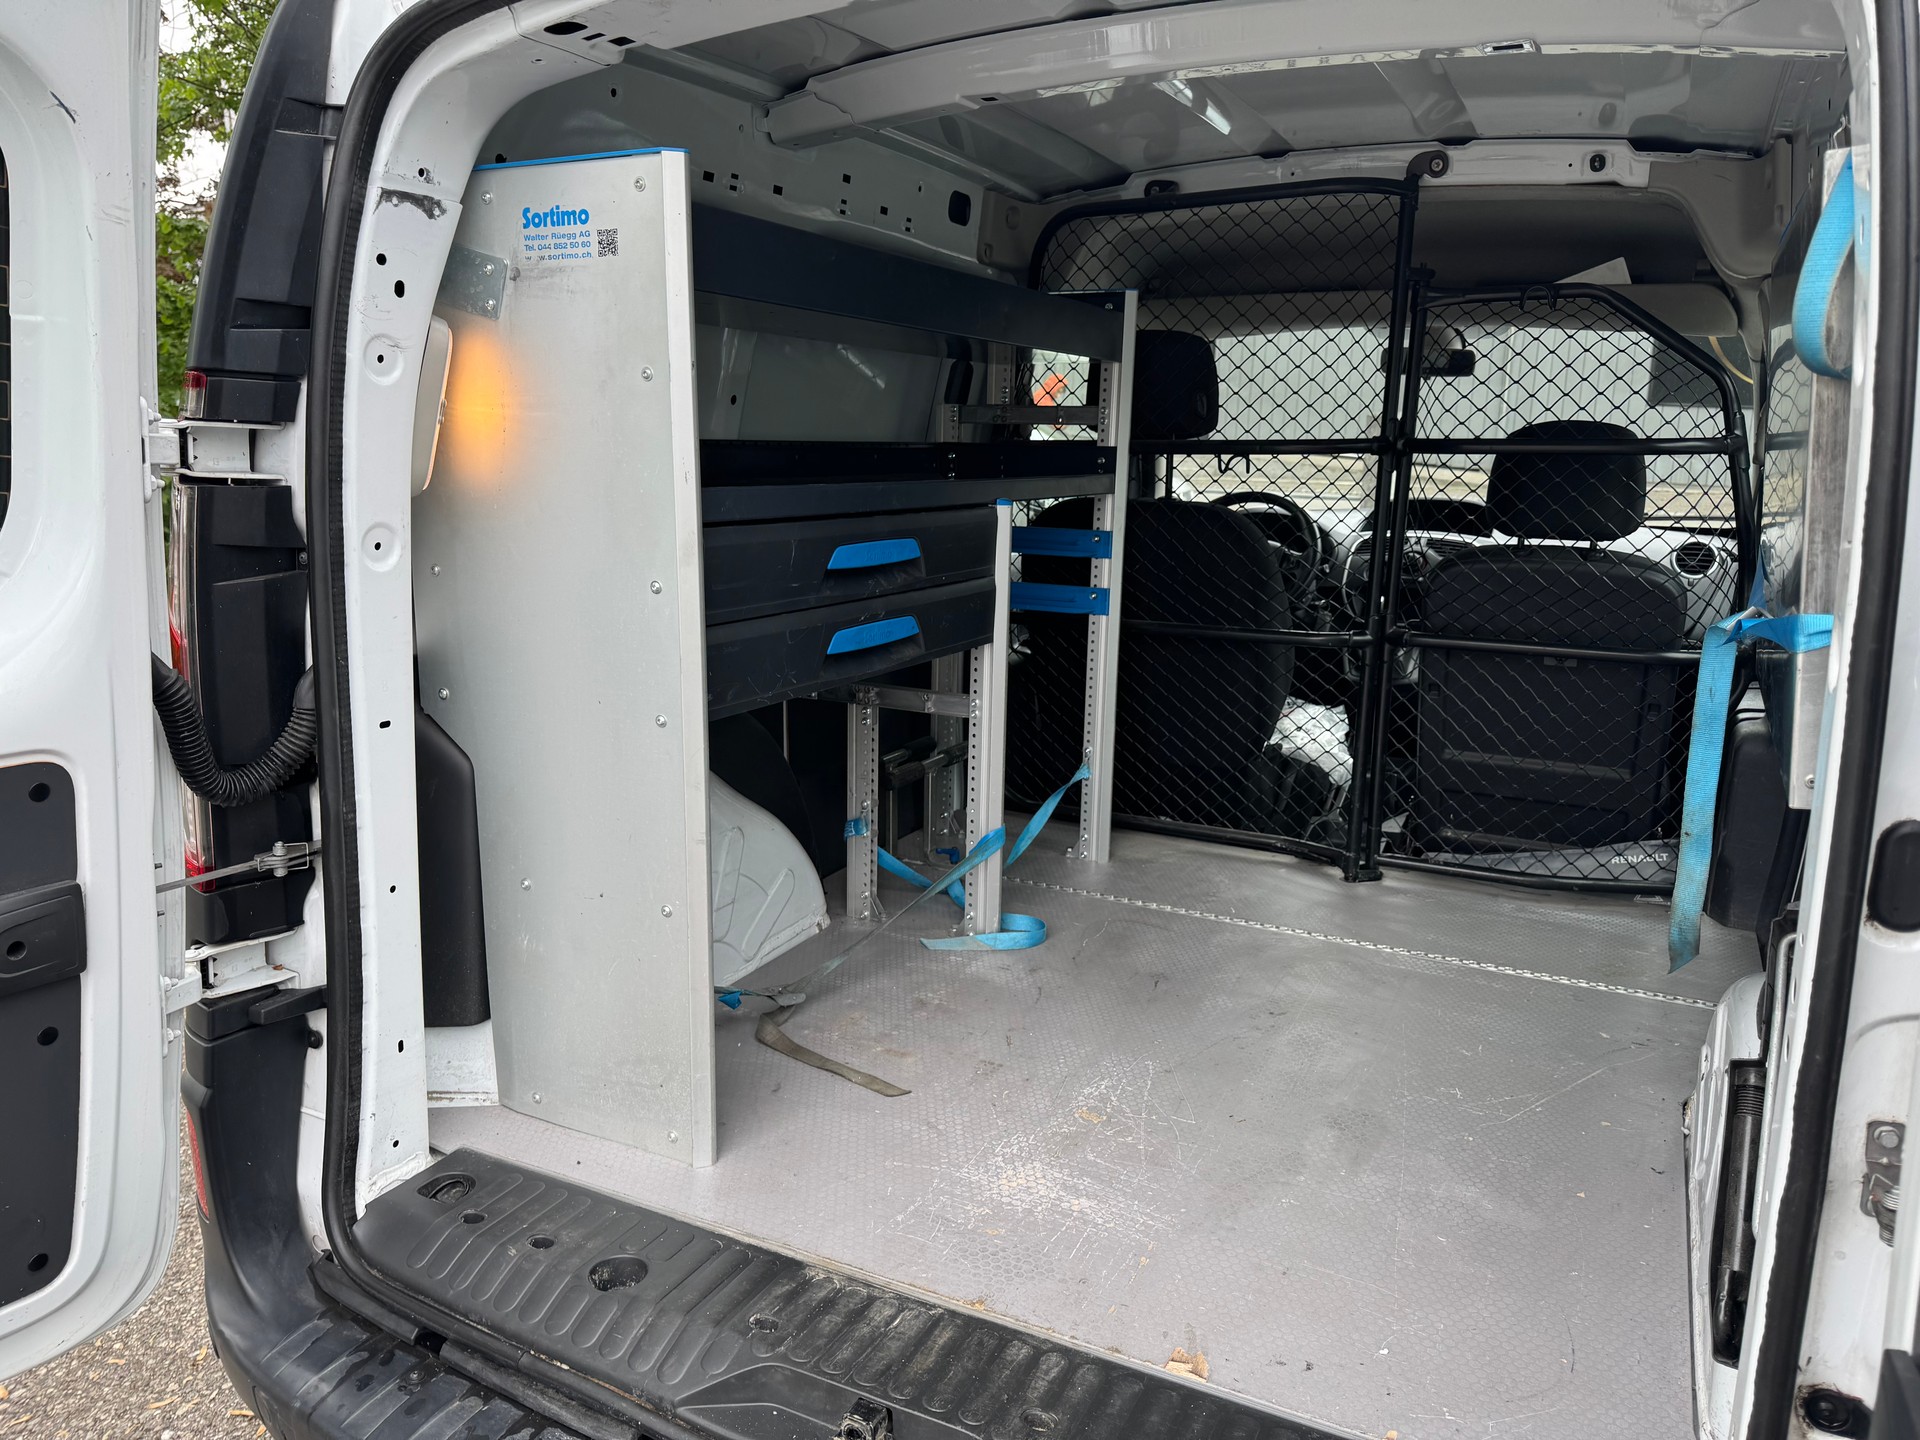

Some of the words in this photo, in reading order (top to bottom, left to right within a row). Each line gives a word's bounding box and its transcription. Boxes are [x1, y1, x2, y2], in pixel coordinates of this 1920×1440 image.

[522, 205, 589, 229] Sortimo
[551, 232, 577, 240] Rüegg
[579, 230, 591, 238] AG
[524, 244, 536, 252] Tel.
[569, 241, 580, 249] 50
[581, 240, 591, 249] 60
[1611, 853, 1669, 864] RENAULT
